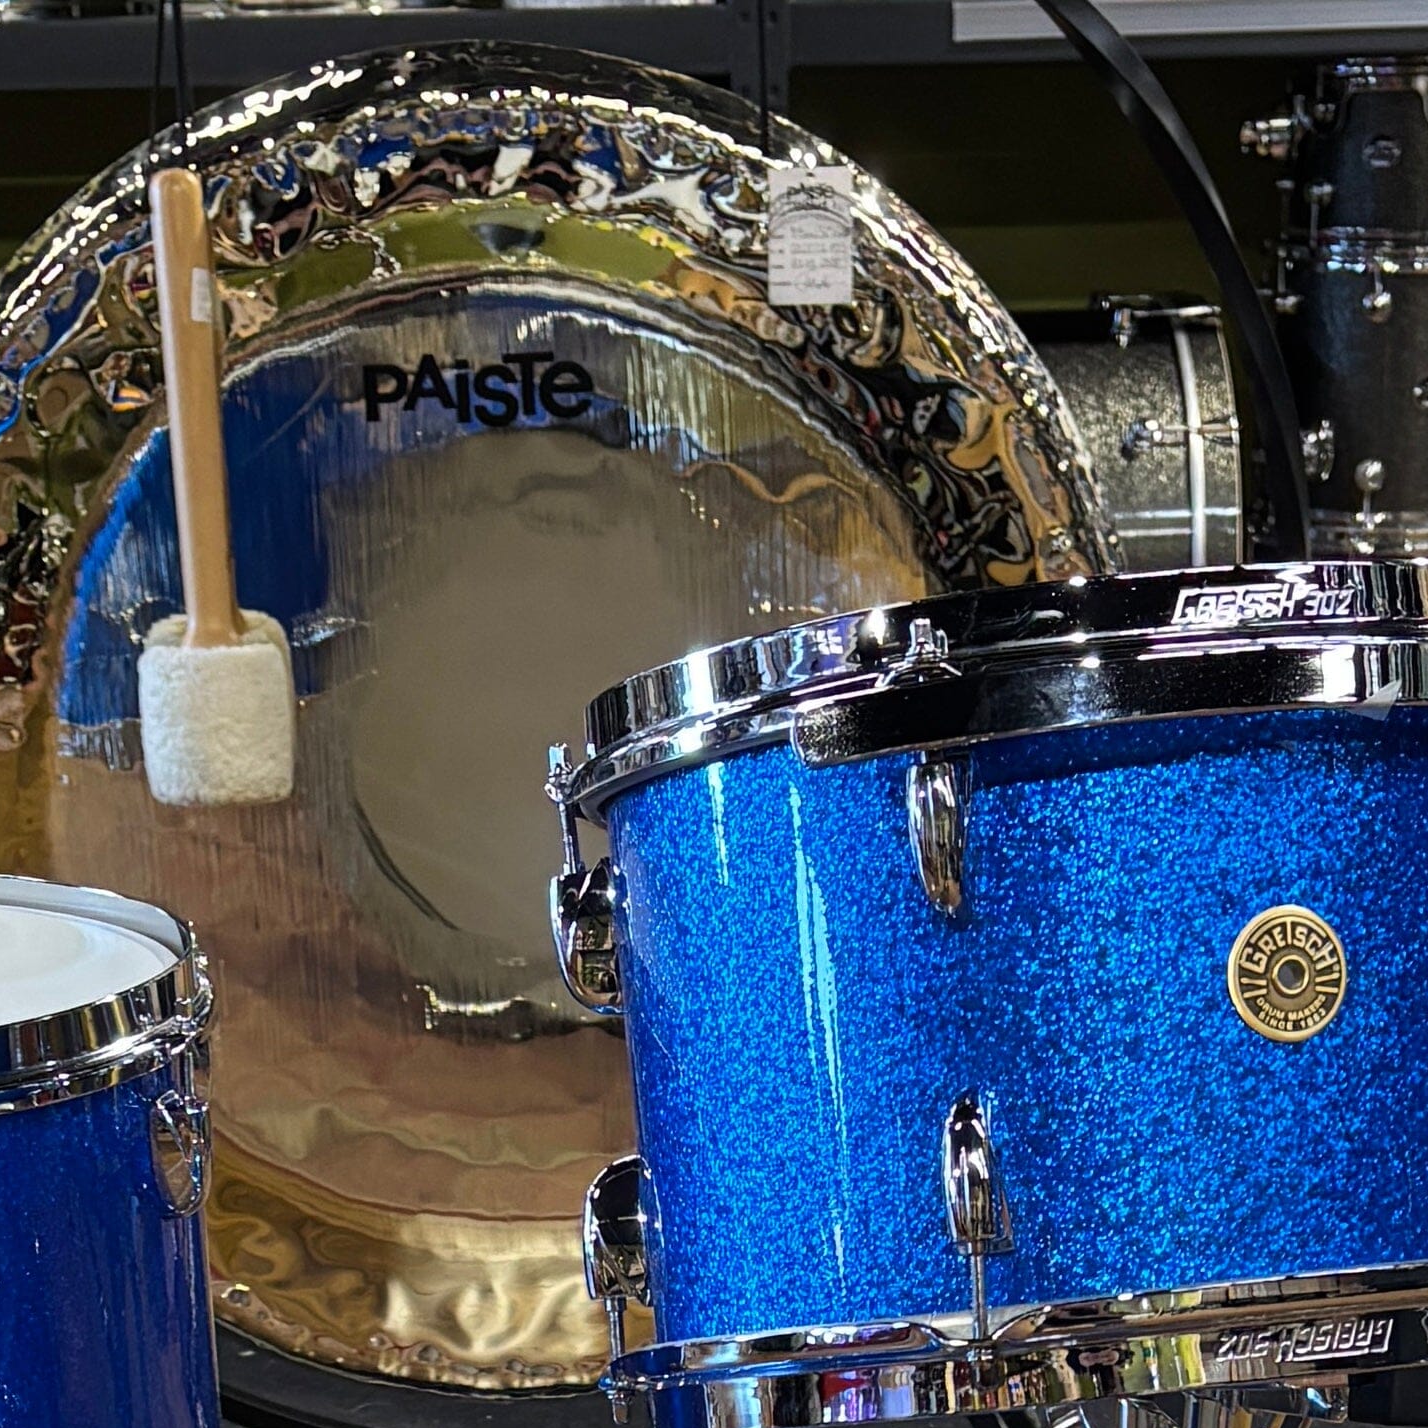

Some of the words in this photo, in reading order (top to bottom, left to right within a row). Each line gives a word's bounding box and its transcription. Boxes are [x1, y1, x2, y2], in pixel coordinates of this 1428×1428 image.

[1239, 915, 1338, 975] GRETSCH
[1256, 997, 1286, 1019] DRUM
[1258, 1011, 1294, 1031] SINCE
